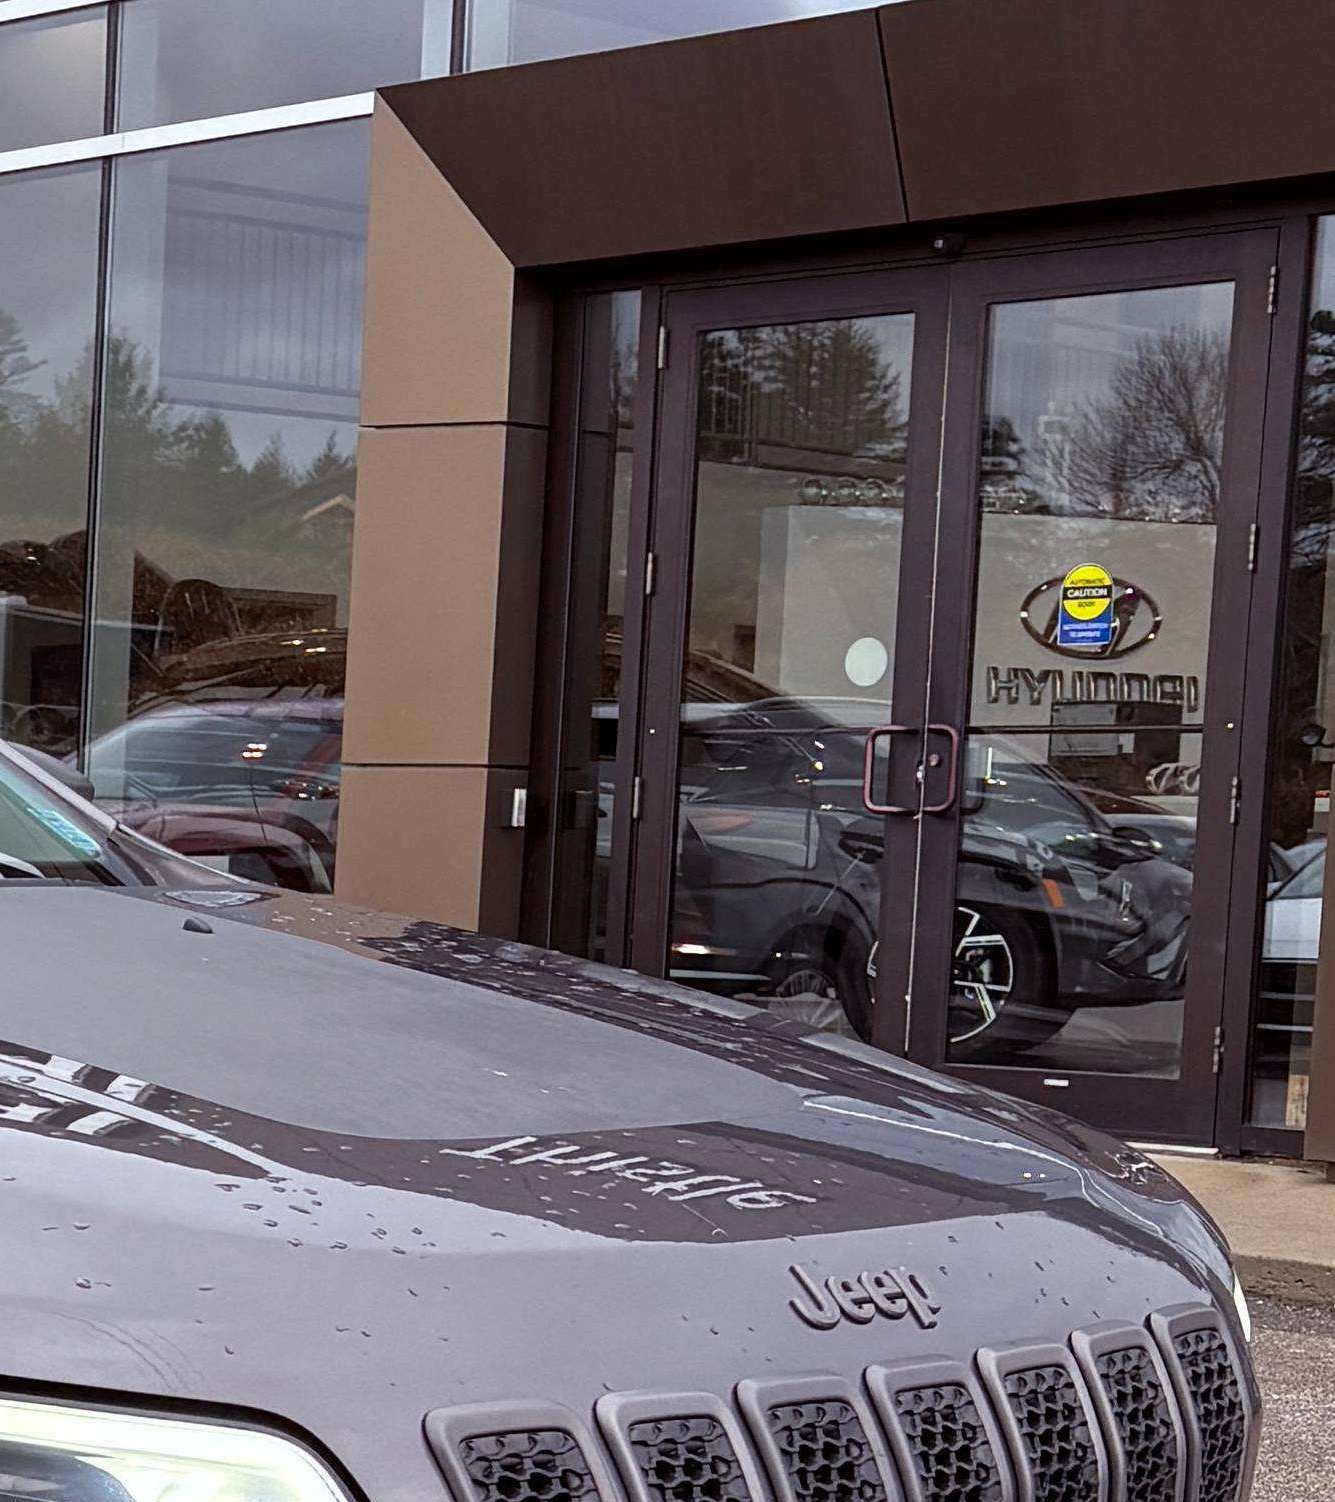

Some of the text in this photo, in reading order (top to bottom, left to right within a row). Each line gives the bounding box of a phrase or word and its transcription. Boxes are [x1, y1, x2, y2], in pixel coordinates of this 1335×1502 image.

[1067, 587, 1108, 598] CAUTION
[986, 666, 1199, 714] HYUNDAI
[789, 1264, 941, 1331] Jeep
